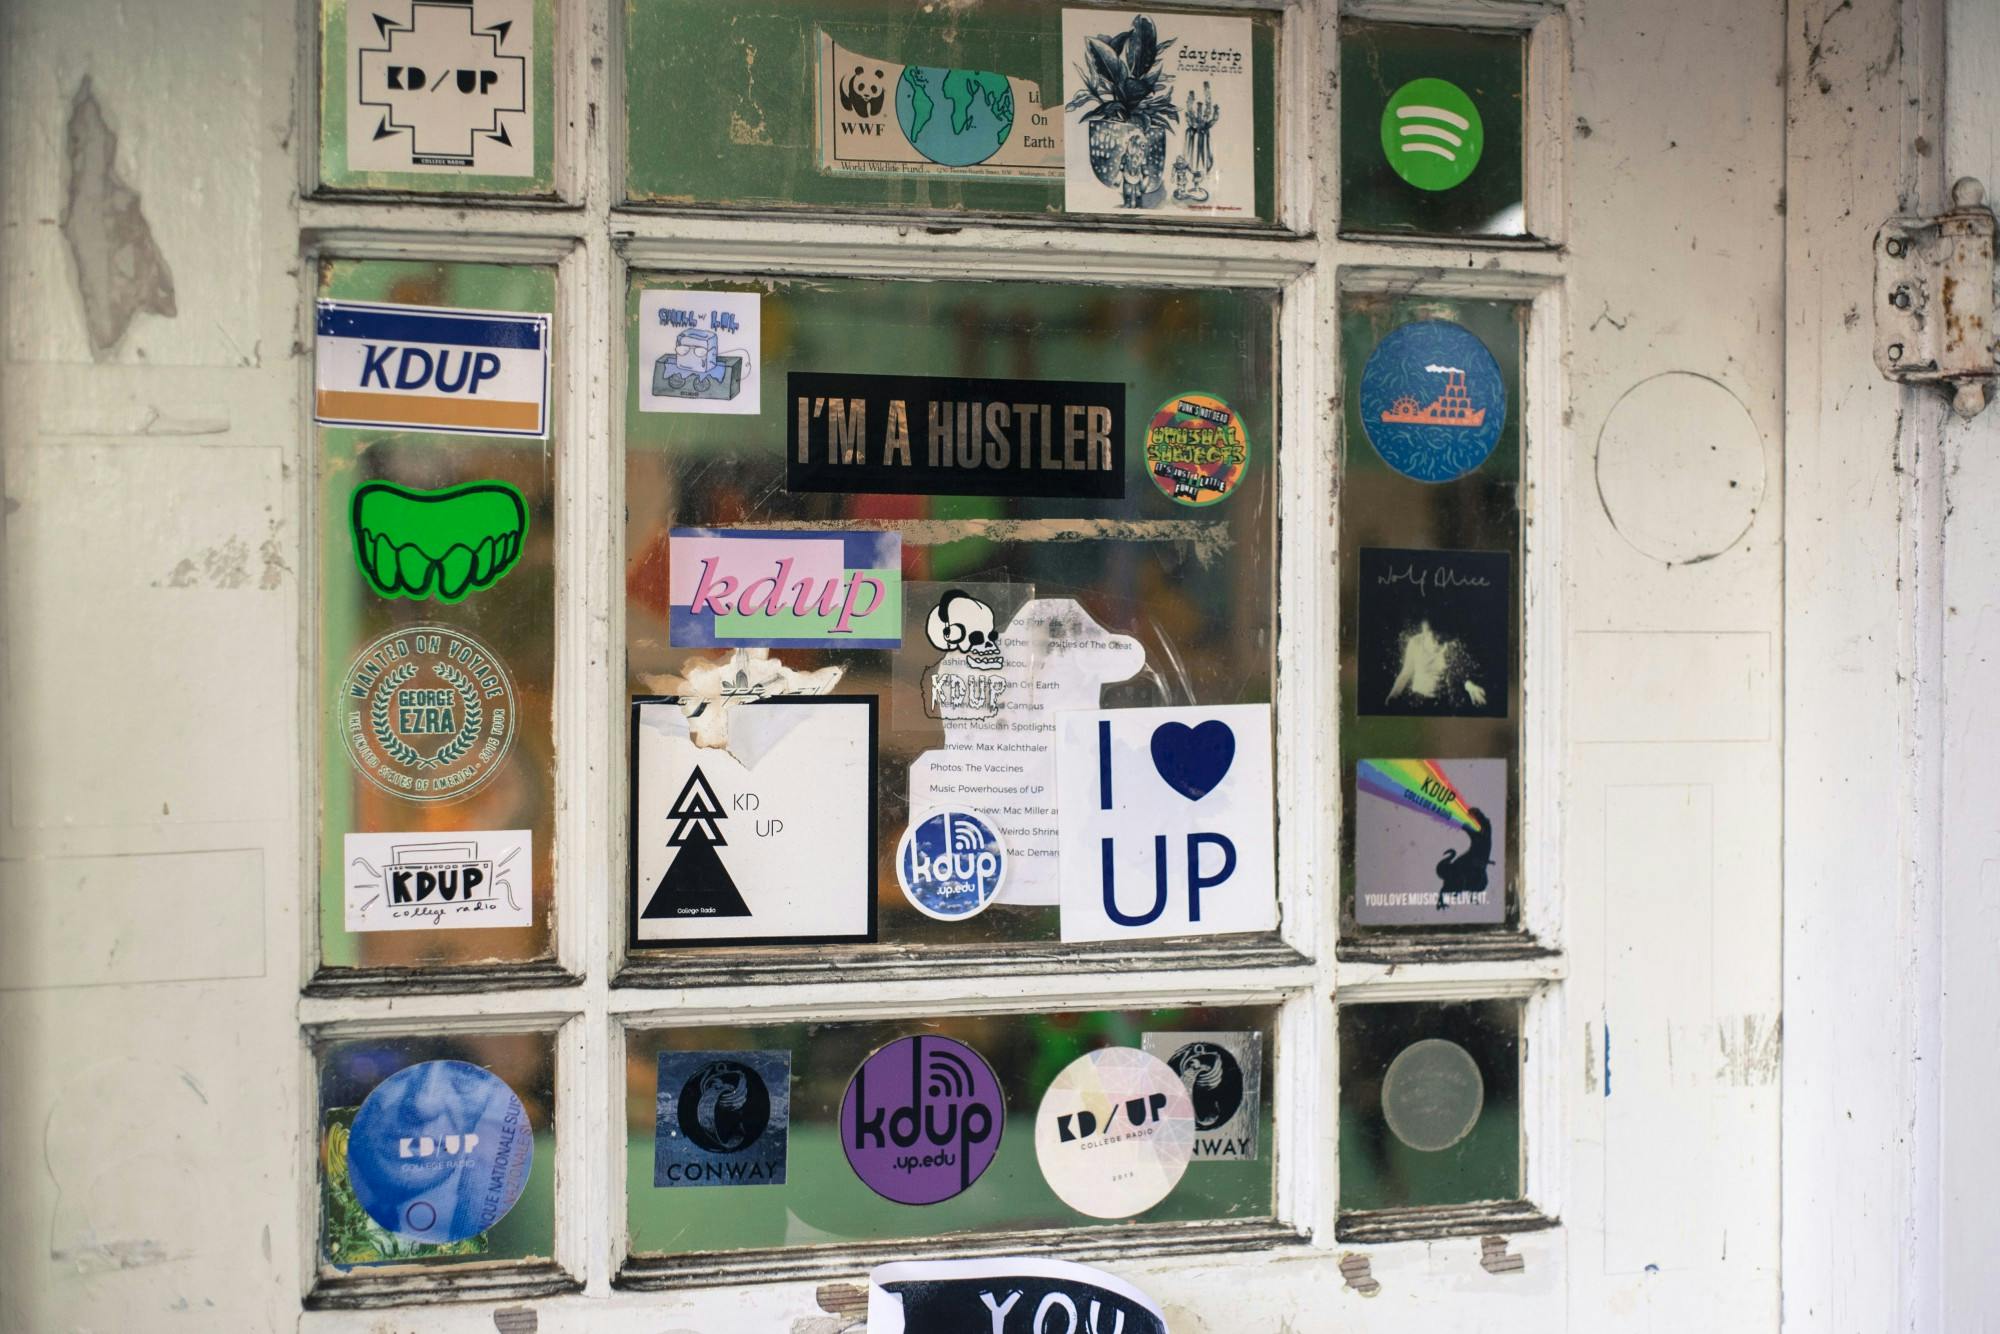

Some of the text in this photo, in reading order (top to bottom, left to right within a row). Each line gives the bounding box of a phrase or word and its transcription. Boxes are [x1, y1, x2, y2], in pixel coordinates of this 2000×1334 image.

[1031, 113, 1048, 126] On
[841, 122, 886, 136] WWF
[1024, 135, 1055, 149] Earth
[841, 161, 865, 172] World
[360, 344, 501, 394] KDUP
[883, 399, 912, 466] A
[928, 400, 1113, 471] HUSTLER
[690, 556, 885, 633] kdup
[1080, 640, 1088, 649] of
[1090, 640, 1106, 650] The
[350, 636, 504, 700] WANTED ON VOYAGE
[1036, 681, 1060, 690] Earth
[399, 690, 455, 706] GEORGE
[1007, 701, 1044, 712] Campus
[399, 708, 456, 734] EZRA
[970, 721, 1009, 731] Musician
[1011, 722, 1056, 733] Spotlights
[976, 743, 994, 752] Max
[997, 743, 1048, 752] Kalchthaler
[930, 763, 1024, 773] Photos: The Vaccines
[1098, 720, 1113, 810] I
[929, 785, 1044, 795] Music Powerhouses of UP
[1420, 775, 1456, 805] KDUP
[733, 793, 760, 811] KD
[1003, 807, 1022, 815] Mac
[1024, 807, 1048, 815] Miller
[756, 819, 784, 837] UP
[1006, 848, 1025, 857] Mac
[392, 868, 484, 903] KDUP
[1101, 832, 1237, 927] UP
[393, 902, 497, 925] college radio
[855, 1036, 993, 1192] kdup
[1080, 1127, 1154, 1151] COLLEGE RADIO
[488, 1124, 516, 1193] NATIONALE
[892, 1149, 956, 1175] .up.edu
[667, 1162, 777, 1181] CONWAY
[978, 1289, 1125, 1334] YOU
